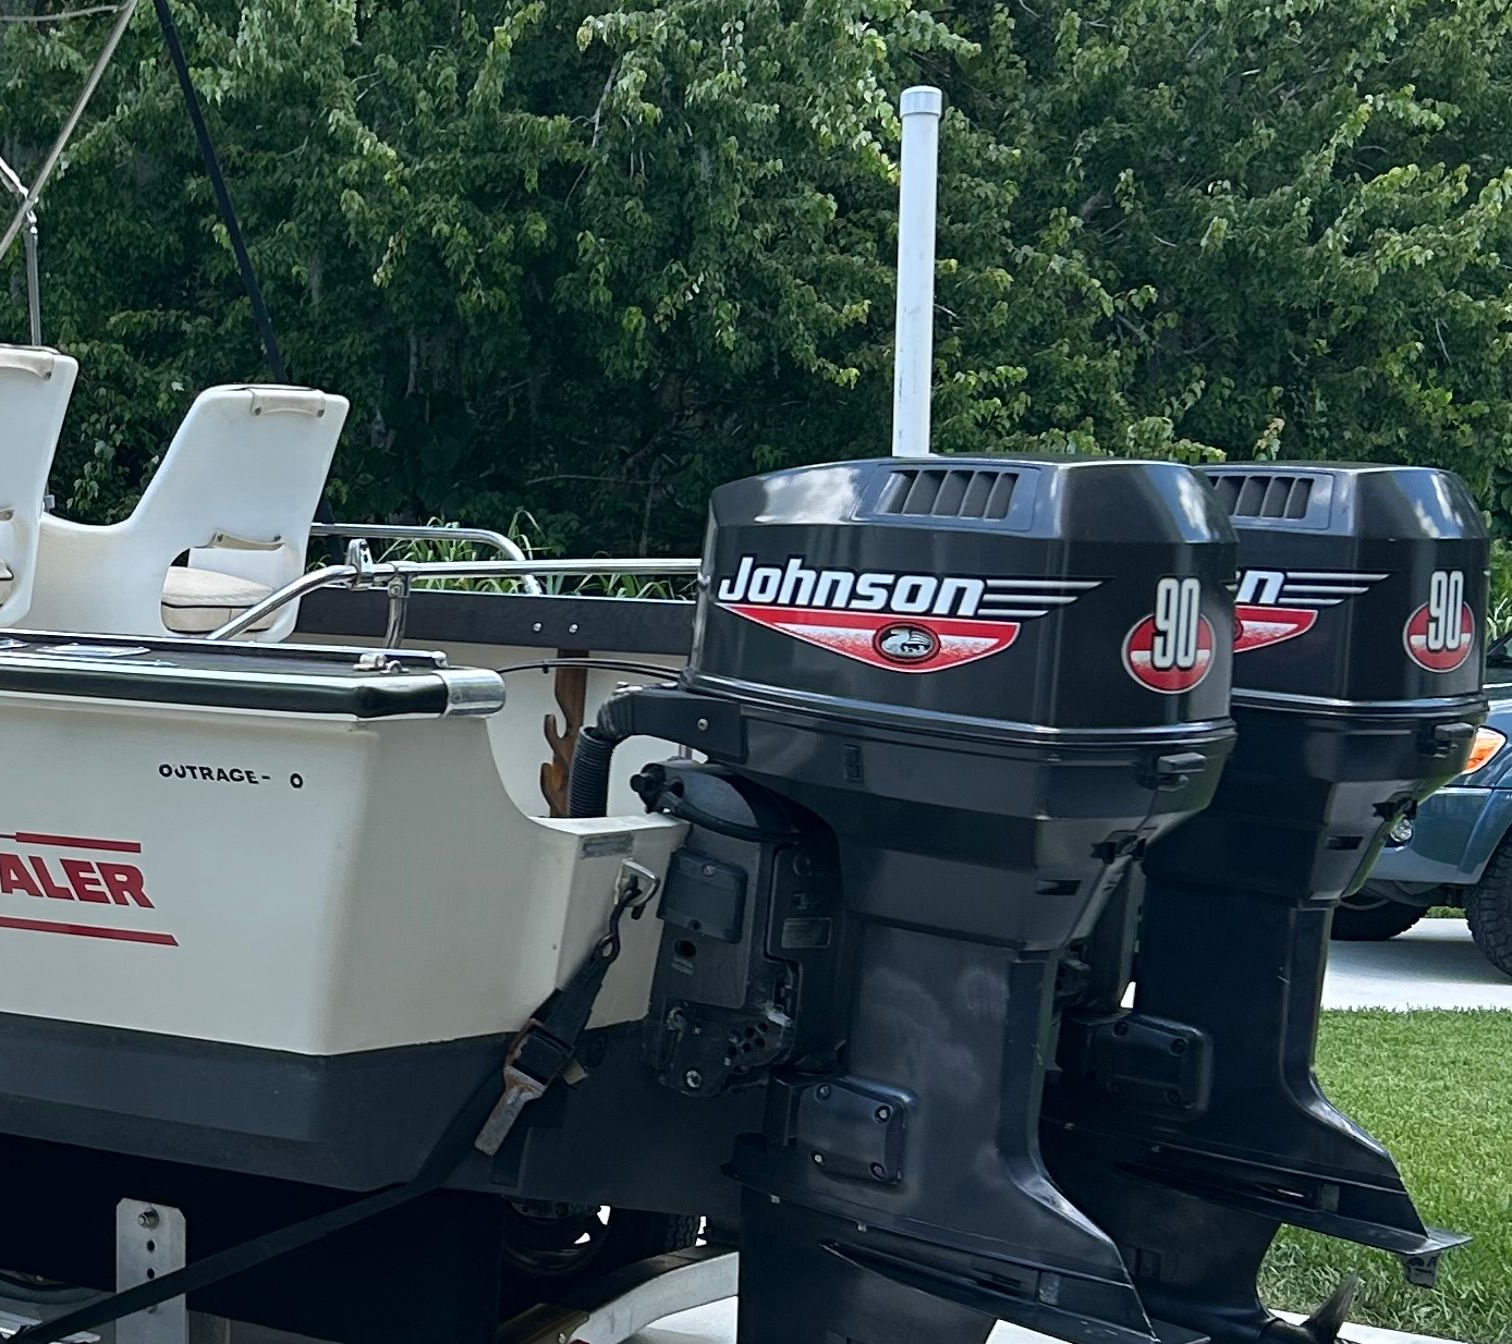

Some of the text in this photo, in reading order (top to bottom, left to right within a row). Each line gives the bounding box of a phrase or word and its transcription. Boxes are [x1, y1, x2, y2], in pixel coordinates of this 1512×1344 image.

[717, 555, 986, 618] Johnson
[1152, 576, 1202, 670] 90
[1427, 569, 1465, 652] 90
